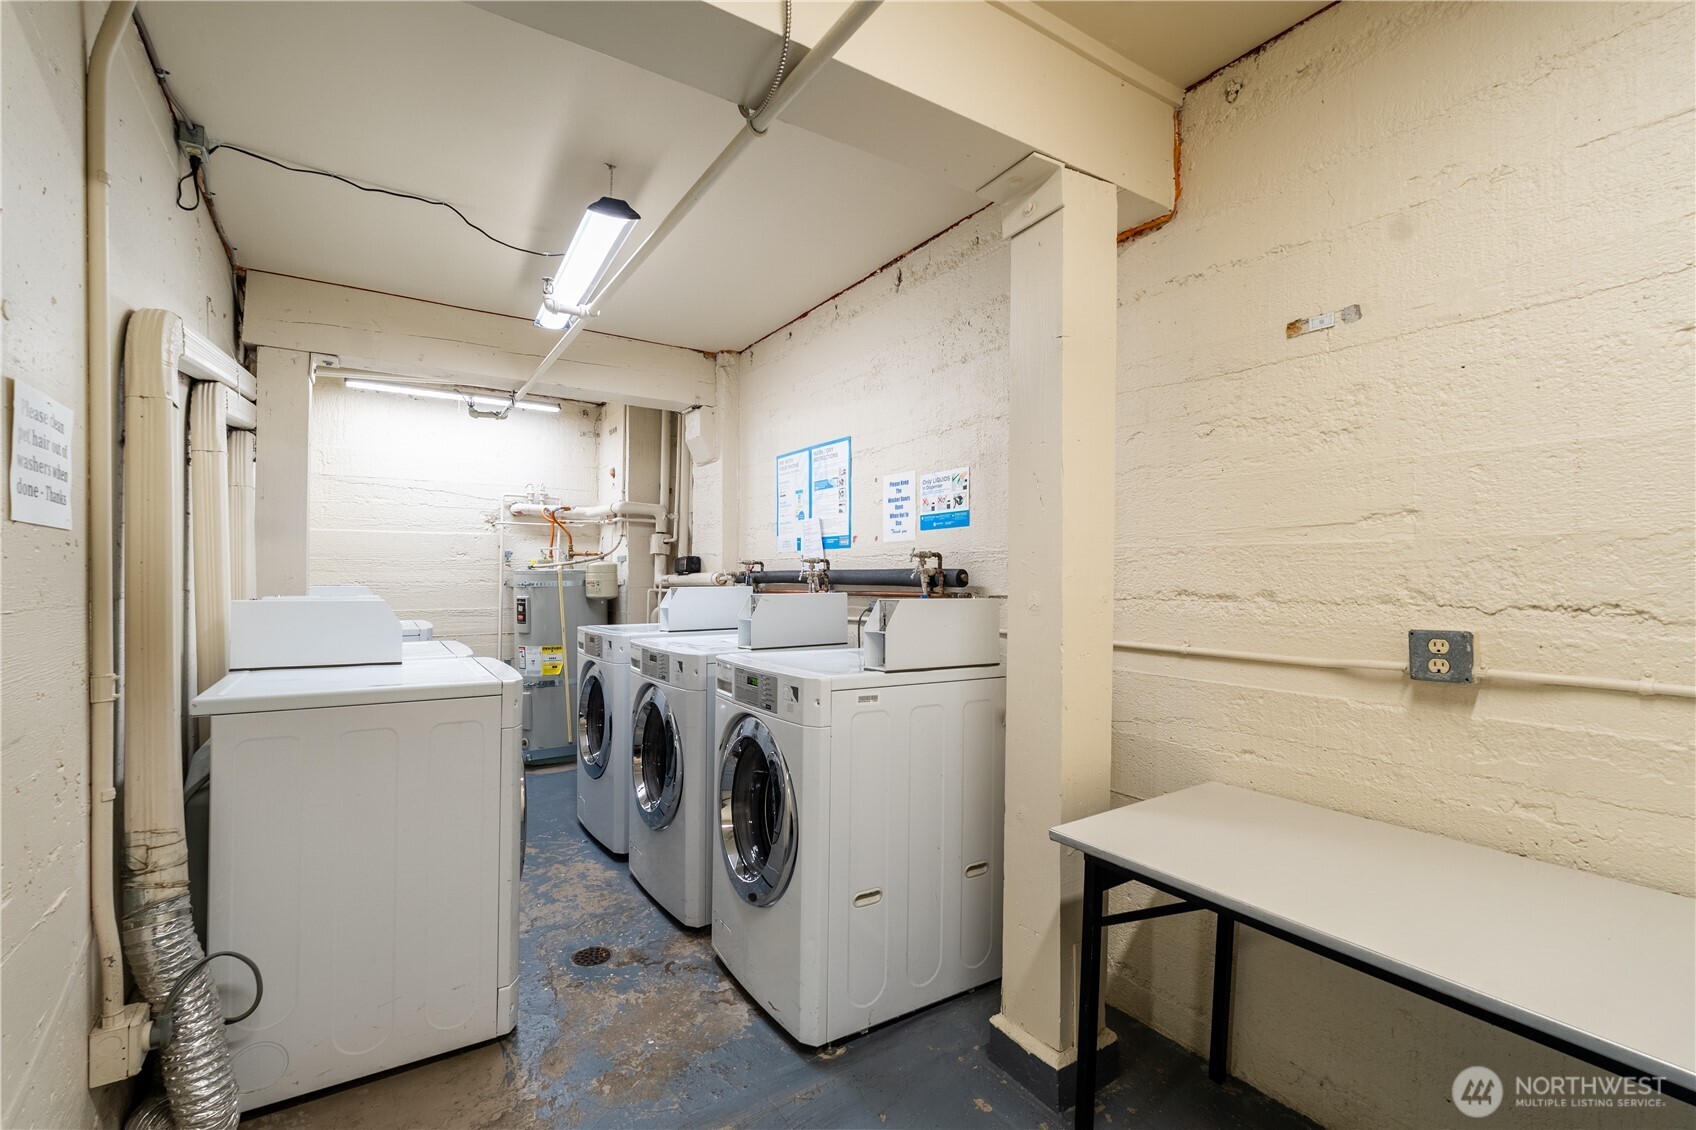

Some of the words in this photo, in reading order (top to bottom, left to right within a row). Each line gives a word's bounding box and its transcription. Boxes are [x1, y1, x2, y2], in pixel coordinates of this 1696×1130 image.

[20, 398, 48, 425] Please
[18, 426, 32, 445] pet
[32, 430, 50, 450] hair
[52, 441, 62, 456] out
[62, 444, 69, 460] of
[16, 453, 52, 477] washers
[52, 464, 69, 483] when
[16, 477, 39, 498] done
[45, 485, 67, 506] Thanks
